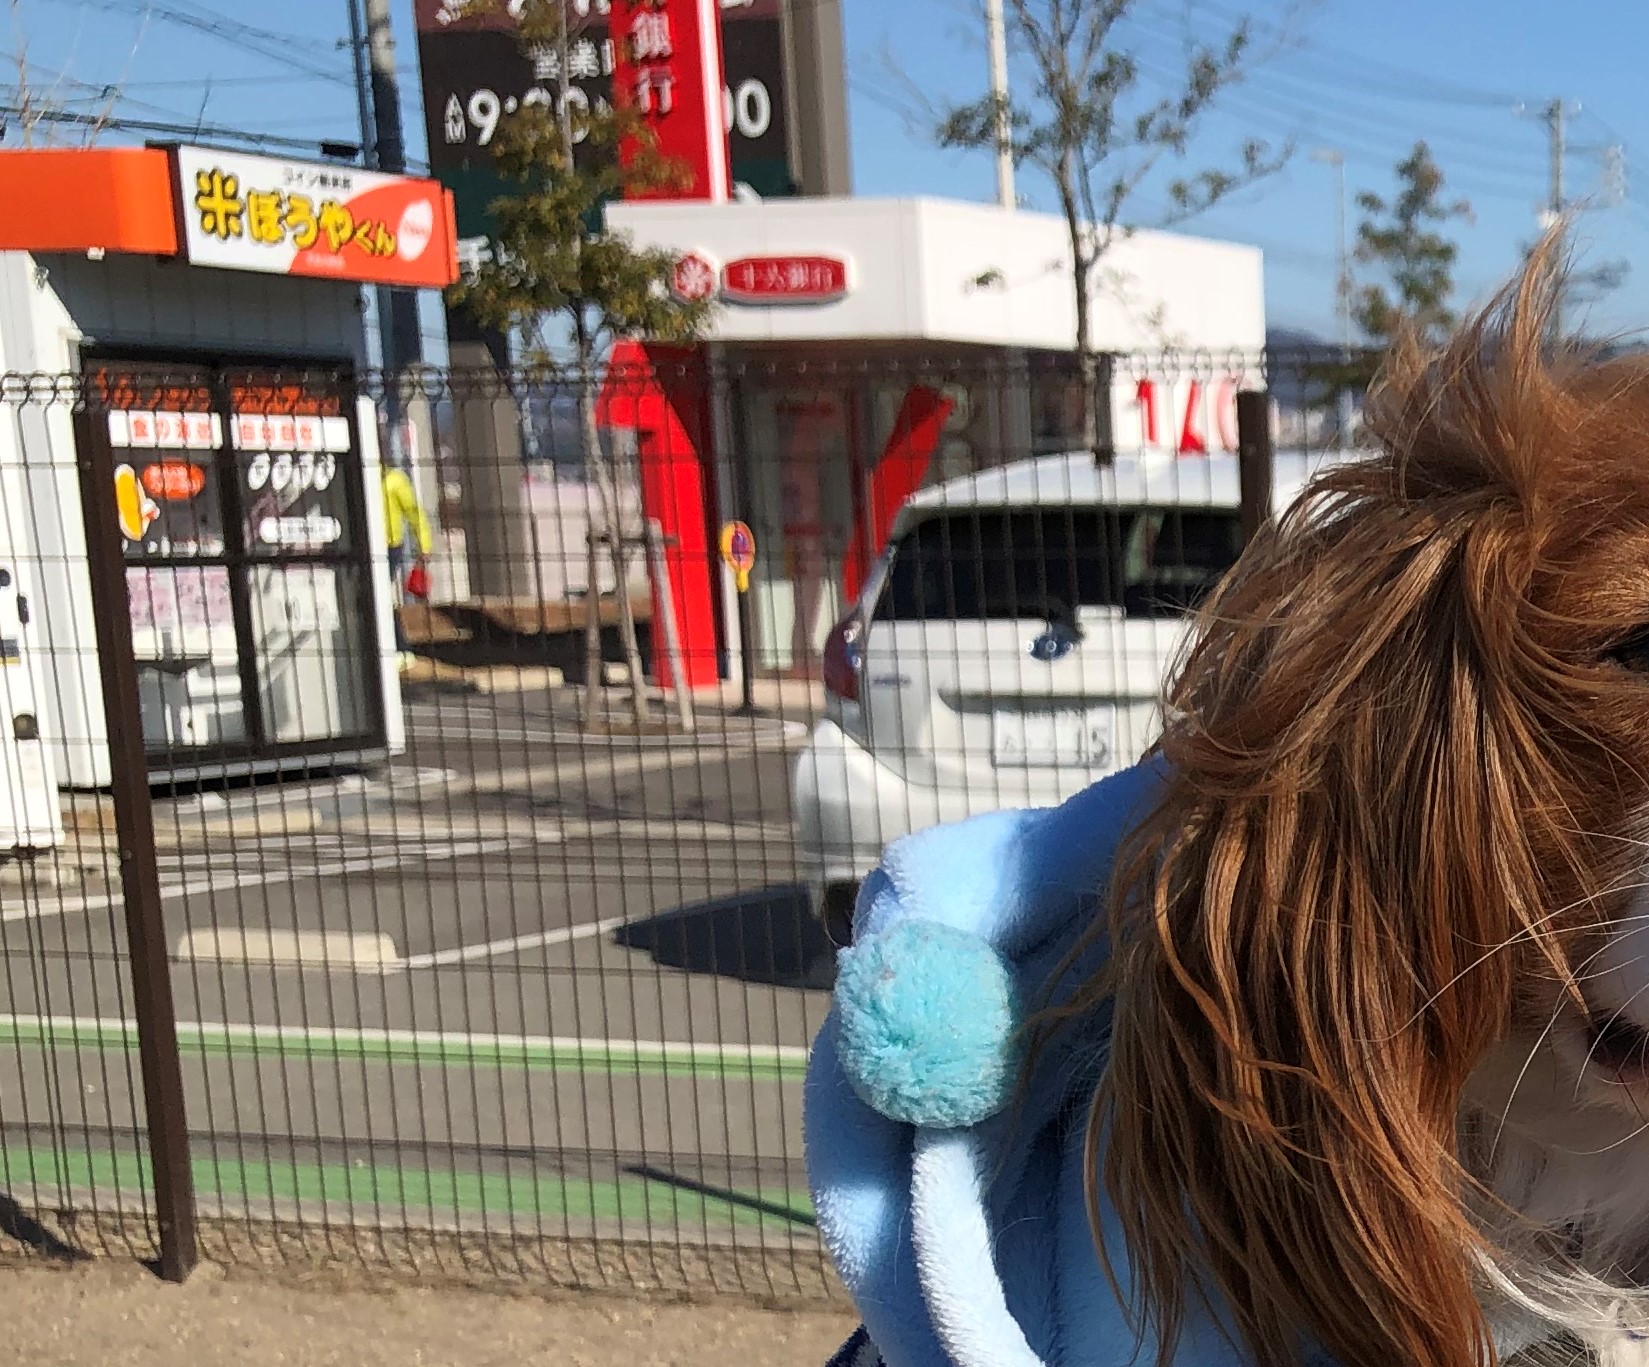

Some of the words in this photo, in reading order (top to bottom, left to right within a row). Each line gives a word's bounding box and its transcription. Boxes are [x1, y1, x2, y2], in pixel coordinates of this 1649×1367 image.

[194, 166, 398, 258] 米ぼうやくん
